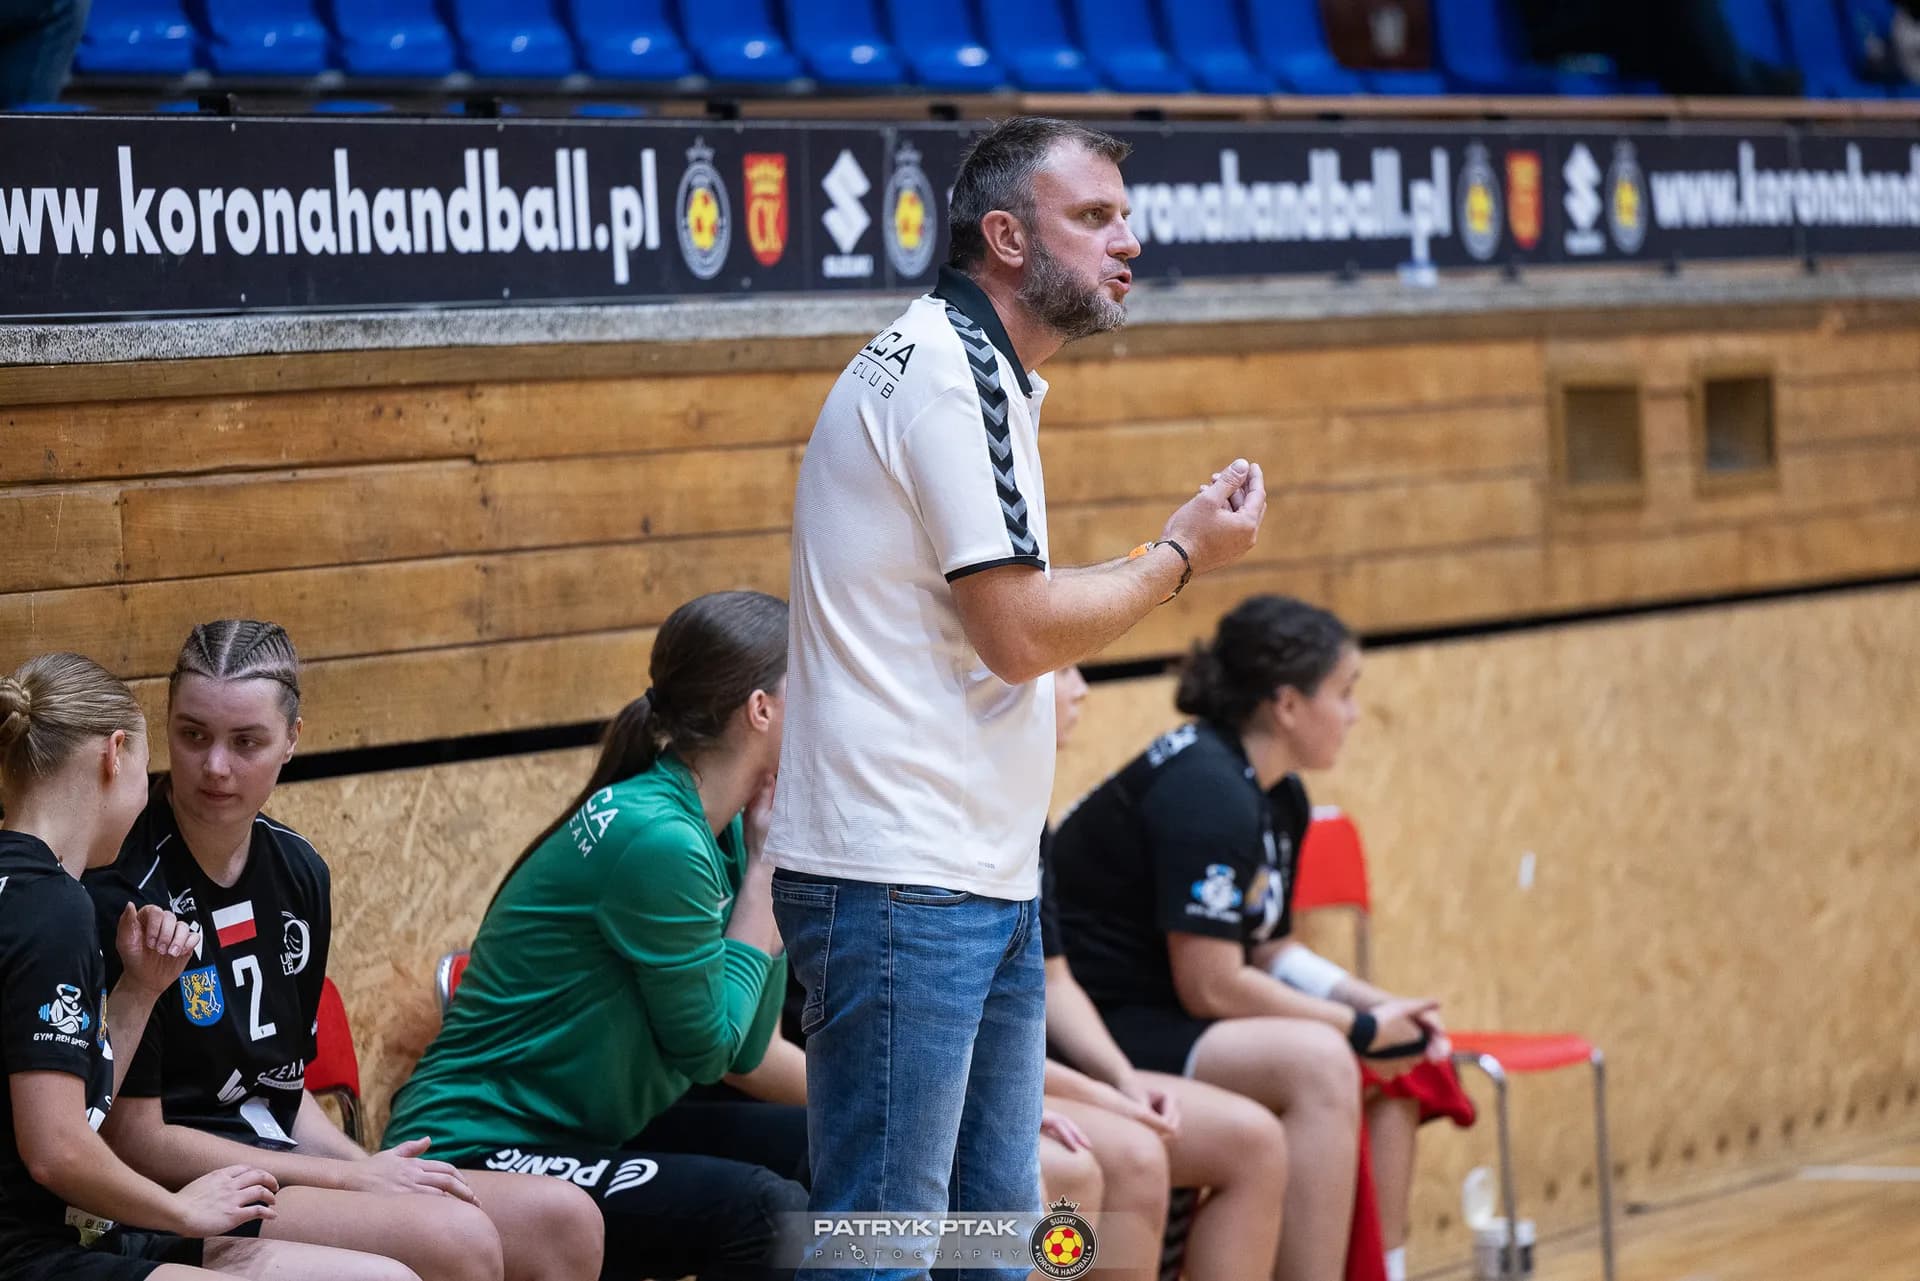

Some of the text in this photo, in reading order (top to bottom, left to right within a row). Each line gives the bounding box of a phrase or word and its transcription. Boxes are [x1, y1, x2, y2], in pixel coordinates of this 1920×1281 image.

[852, 361, 895, 399] CLUB
[231, 954, 277, 1041] 2
[33, 1032, 54, 1042] GYM
